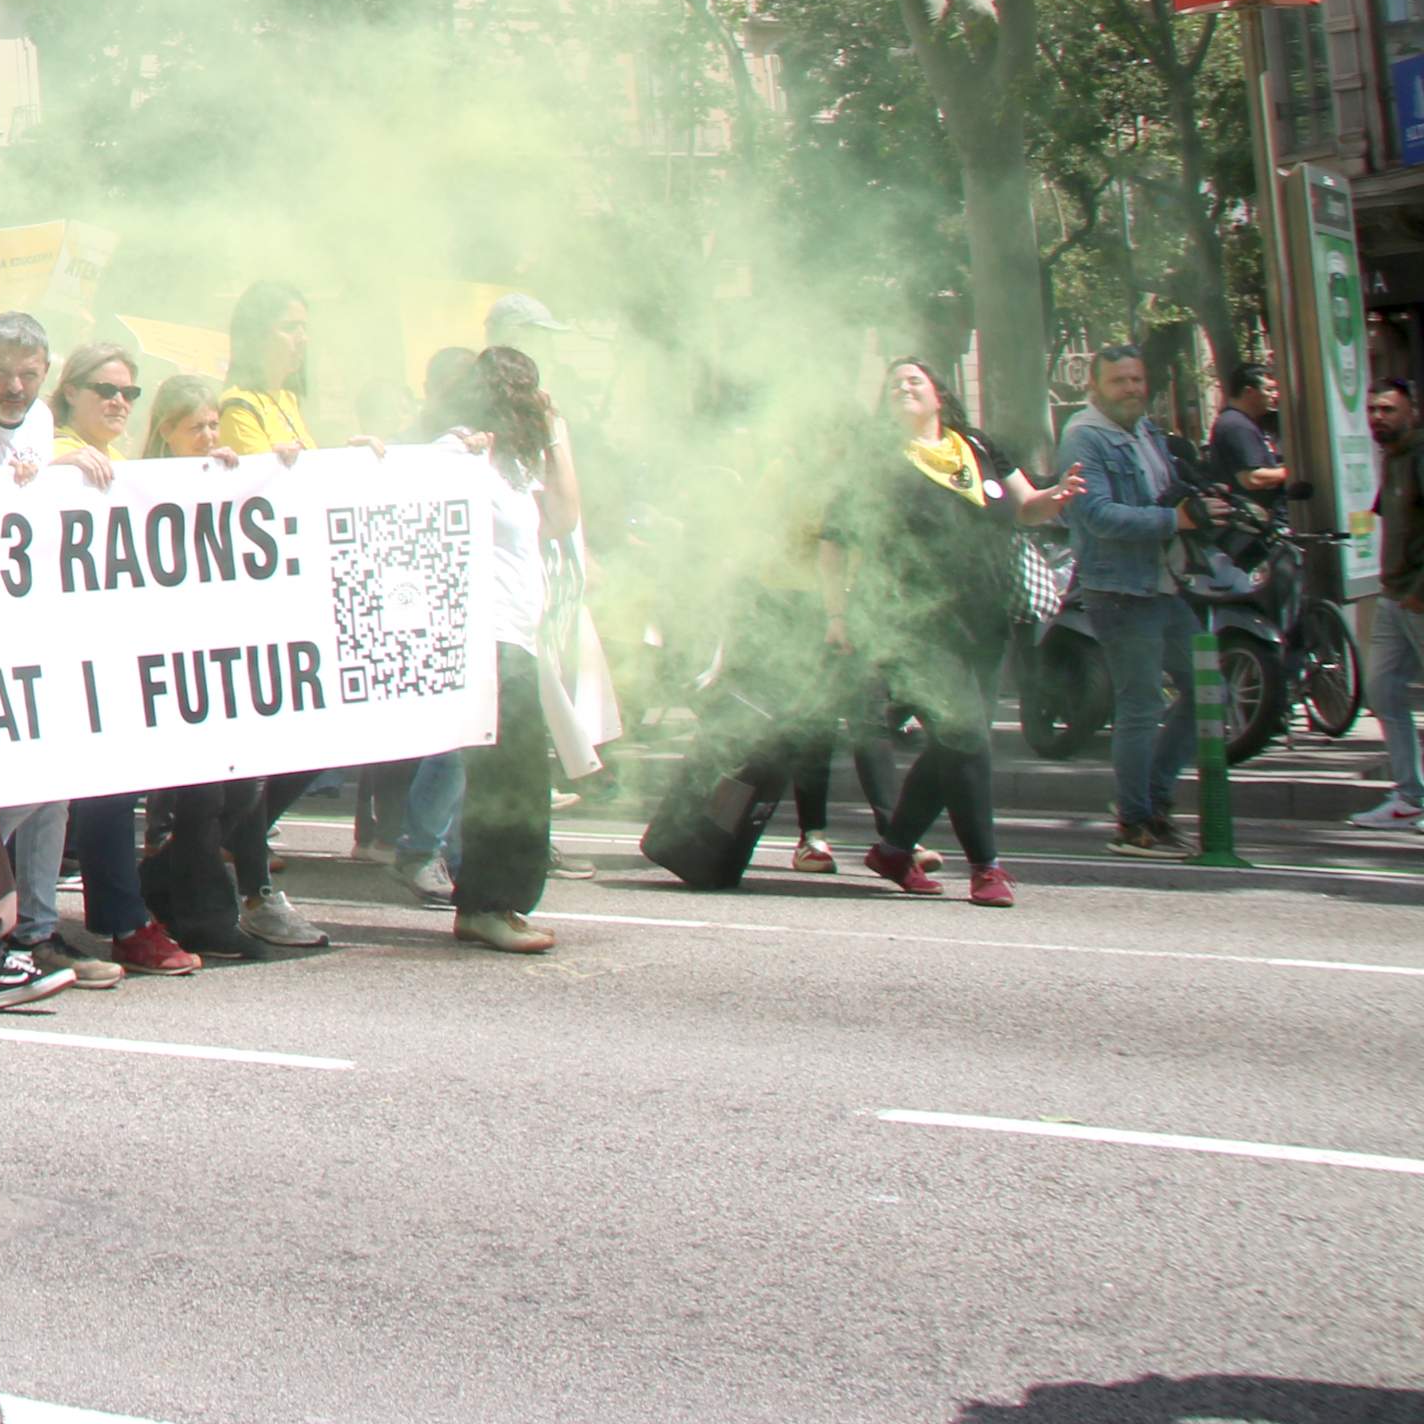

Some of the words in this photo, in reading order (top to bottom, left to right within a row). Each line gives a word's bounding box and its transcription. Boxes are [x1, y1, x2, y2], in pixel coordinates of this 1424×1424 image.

[1, 512, 33, 597] 3
[60, 495, 300, 593] RAONS:
[81, 660, 103, 734] I
[137, 641, 325, 730] FUTUR
